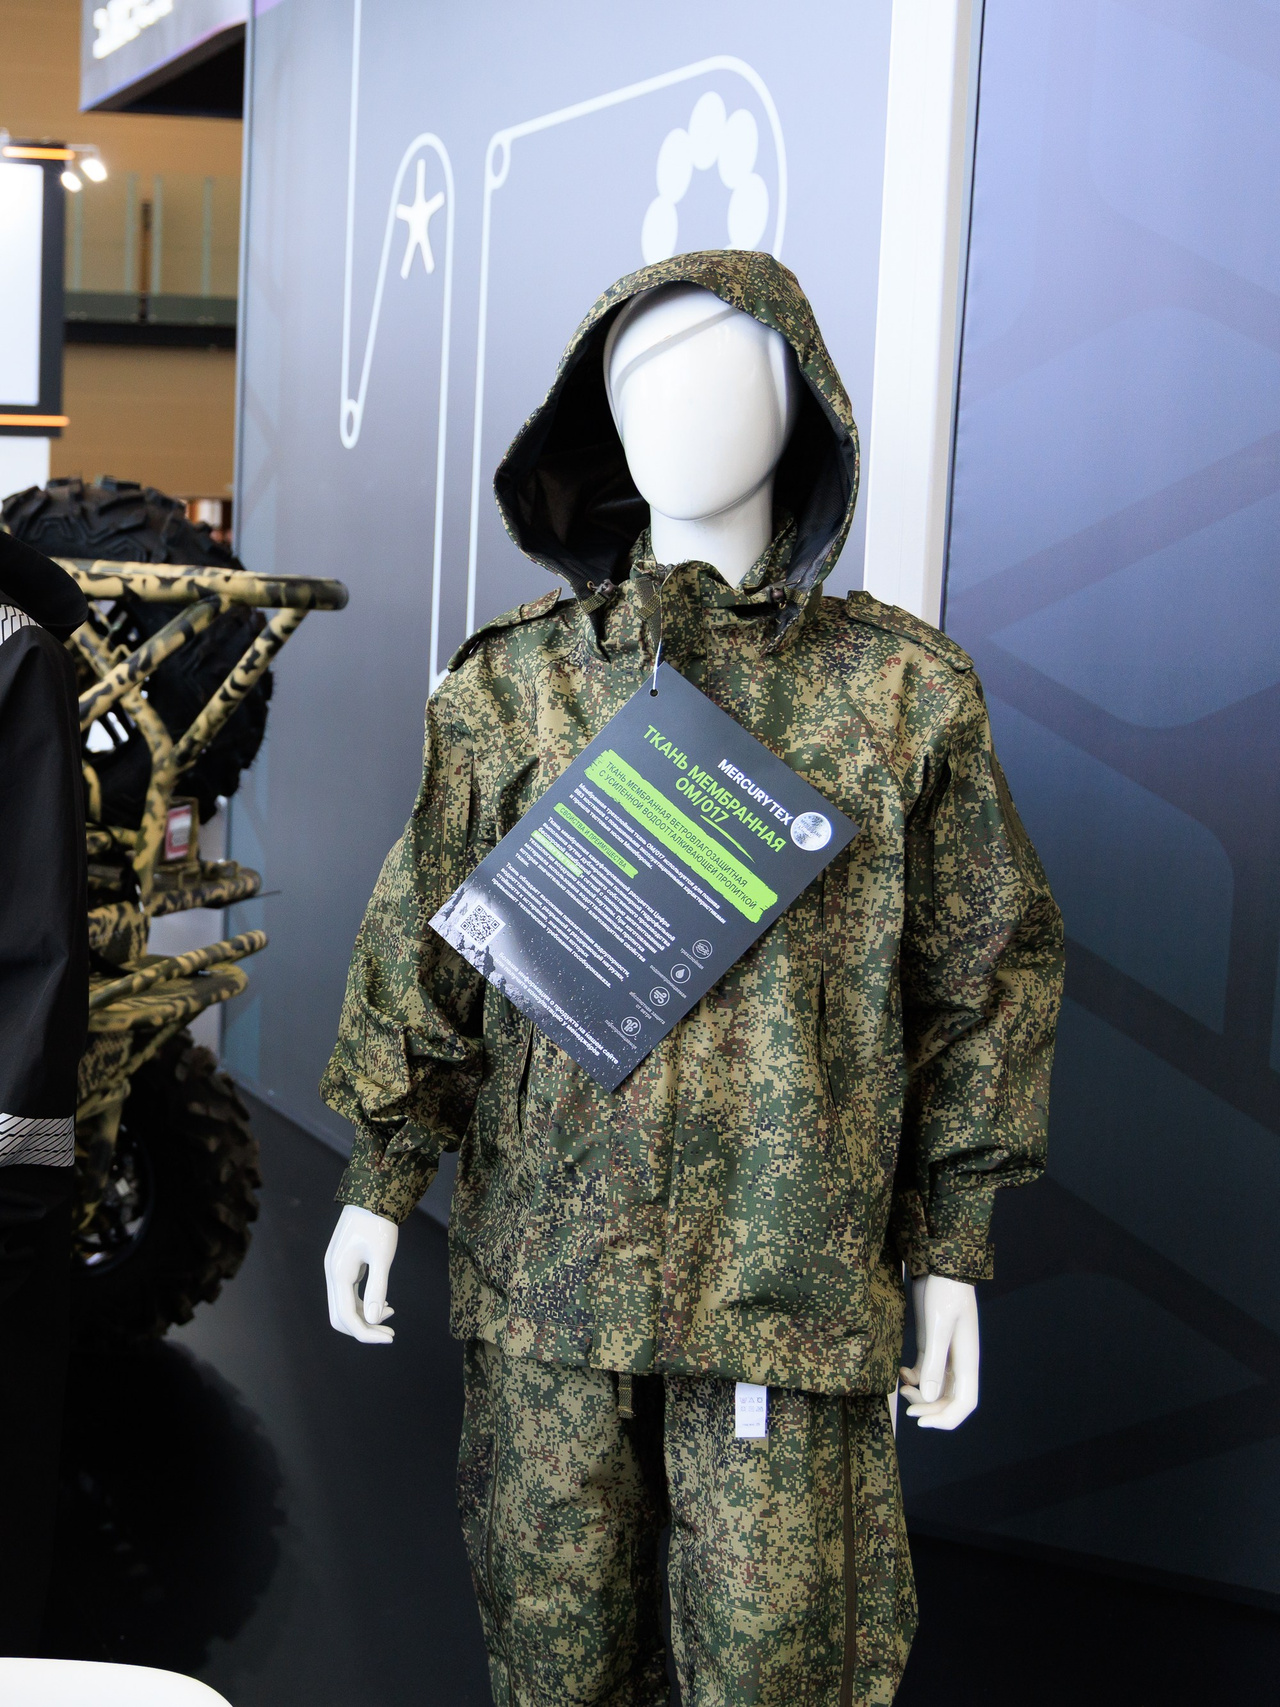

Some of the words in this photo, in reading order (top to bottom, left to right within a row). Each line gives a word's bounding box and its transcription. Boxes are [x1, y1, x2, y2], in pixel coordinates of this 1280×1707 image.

[558, 806, 586, 832] СВОЙСТВА
[587, 832, 627, 869] ПРЕИМУЩЕСТВА
[571, 796, 591, 815] прошла
[589, 811, 611, 832] тестовые
[609, 829, 625, 844] носки
[597, 768, 606, 777] С
[603, 773, 644, 810] УСИЛЕННОЙ
[640, 806, 718, 876] ВОДООТТАЛКИВАЮЩЕЙ
[715, 871, 757, 910] ПРОПИТКОЙ
[604, 761, 628, 783] ТКАНЬ
[625, 779, 672, 821] МЕМБРАННАЯ
[667, 817, 748, 888] ВЕТРОВЛАГОЗАЩИТНАЯ
[639, 723, 693, 771] ТКАНЬ
[686, 763, 787, 853] МЕМБРАННАЯ
[716, 758, 794, 826] MERCURYTEX
[522, 841, 549, 867] материала
[547, 863, 580, 893] использована
[620, 930, 645, 953] пропитка
[528, 836, 555, 862] технологии
[552, 859, 577, 883] воздушно
[575, 879, 597, 899] клеевой
[593, 896, 617, 918] паутины.
[613, 914, 627, 927] При
[624, 923, 657, 954] изготовлении
[541, 821, 568, 846] выполнена
[565, 843, 582, 859] путем
[579, 855, 615, 888] дублирования
[611, 883, 643, 913] полимерной
[639, 908, 676, 943] гидрофильной
[546, 816, 563, 831] Ткань
[559, 828, 590, 857] мембранная
[586, 852, 631, 893] камуфлированной
[627, 889, 654, 915] расцветки
[651, 910, 671, 929] Цифра
[577, 782, 608, 810] Мембранная
[604, 806, 635, 835] трехслойная
[632, 831, 647, 845] ткань
[661, 857, 694, 888] используется
[691, 884, 703, 895] для
[700, 892, 720, 910] пошива
[582, 796, 606, 818] костюмов
[607, 818, 641, 849] повышенными
[681, 885, 726, 925] характеристиками
[490, 877, 519, 904] превышают
[517, 901, 547, 929] технические
[543, 925, 574, 953] требования
[495, 871, 521, 895] стойкости
[547, 919, 570, 940] значения
[567, 938, 589, 959] которых
[504, 861, 520, 877] Ткань
[517, 873, 542, 896] обладает
[538, 893, 564, 916] высокими
[561, 913, 595, 945] показателями
[592, 942, 631, 978] водоупорности,
[517, 847, 539, 867] которая
[536, 863, 567, 891] значительно
[564, 888, 589, 911] повышает
[586, 909, 625, 944] влагозащитные
[622, 940, 647, 963] свойства
[540, 904, 569, 930] разрывной
[568, 929, 604, 962] раздирающей
[600, 959, 625, 982] нагрузки,
[589, 873, 608, 891] нашего
[605, 887, 639, 918] собственного
[635, 915, 671, 948] производства
[497, 951, 520, 973] Больше
[516, 969, 551, 1003] информации
[552, 1003, 579, 1029] продукте
[577, 1025, 586, 1034] на
[584, 1032, 604, 1051] нашем
[601, 1047, 620, 1065] сайте
[525, 987, 564, 1024] консультацию
[564, 1023, 600, 1057] менеджеров
